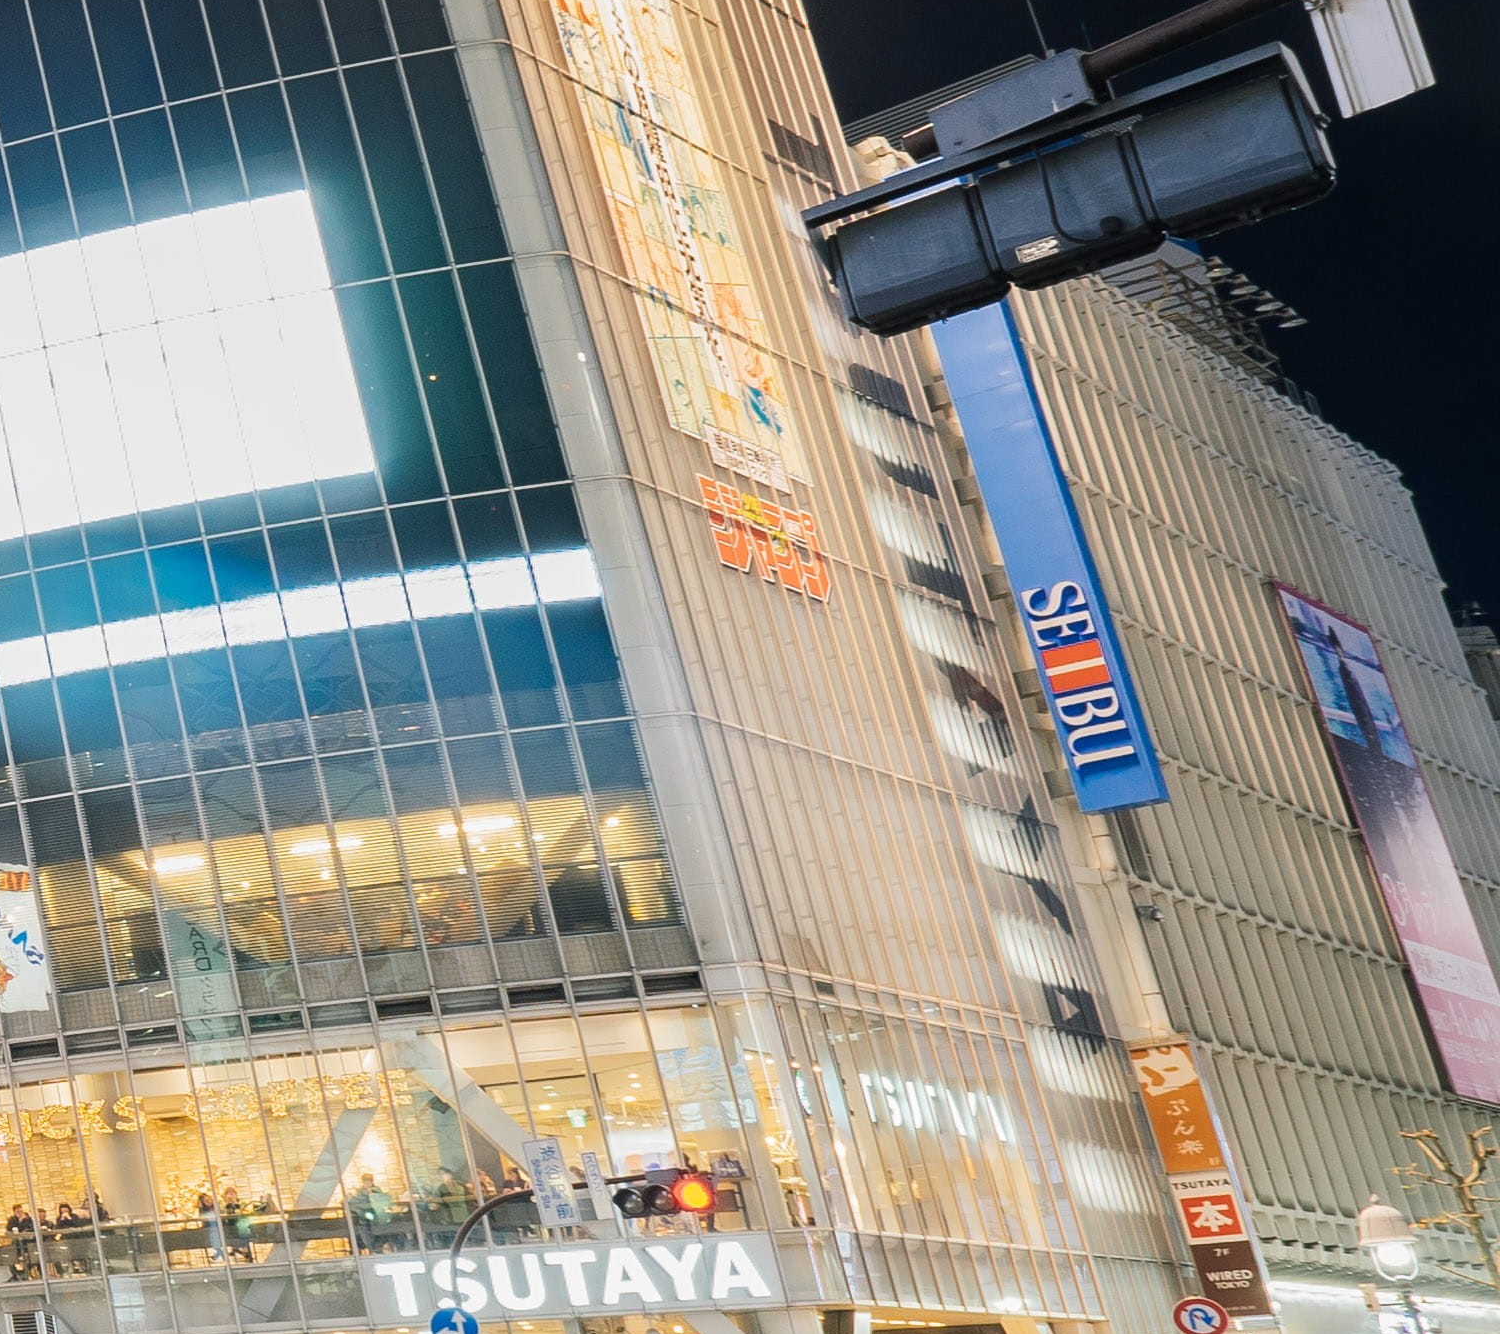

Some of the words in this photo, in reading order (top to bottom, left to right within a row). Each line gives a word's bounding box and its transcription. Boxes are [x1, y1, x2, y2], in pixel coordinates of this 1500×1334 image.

[1021, 579, 1137, 770] SEIBU
[185, 1068, 413, 1124] COFFEE
[1172, 1178, 1231, 1191] TSUTAYA
[1188, 1200, 1234, 1233] 本
[375, 1240, 772, 1319] TSUTAYA
[1205, 1270, 1254, 1282] WIRED
[1214, 1280, 1251, 1290] TOKYO
